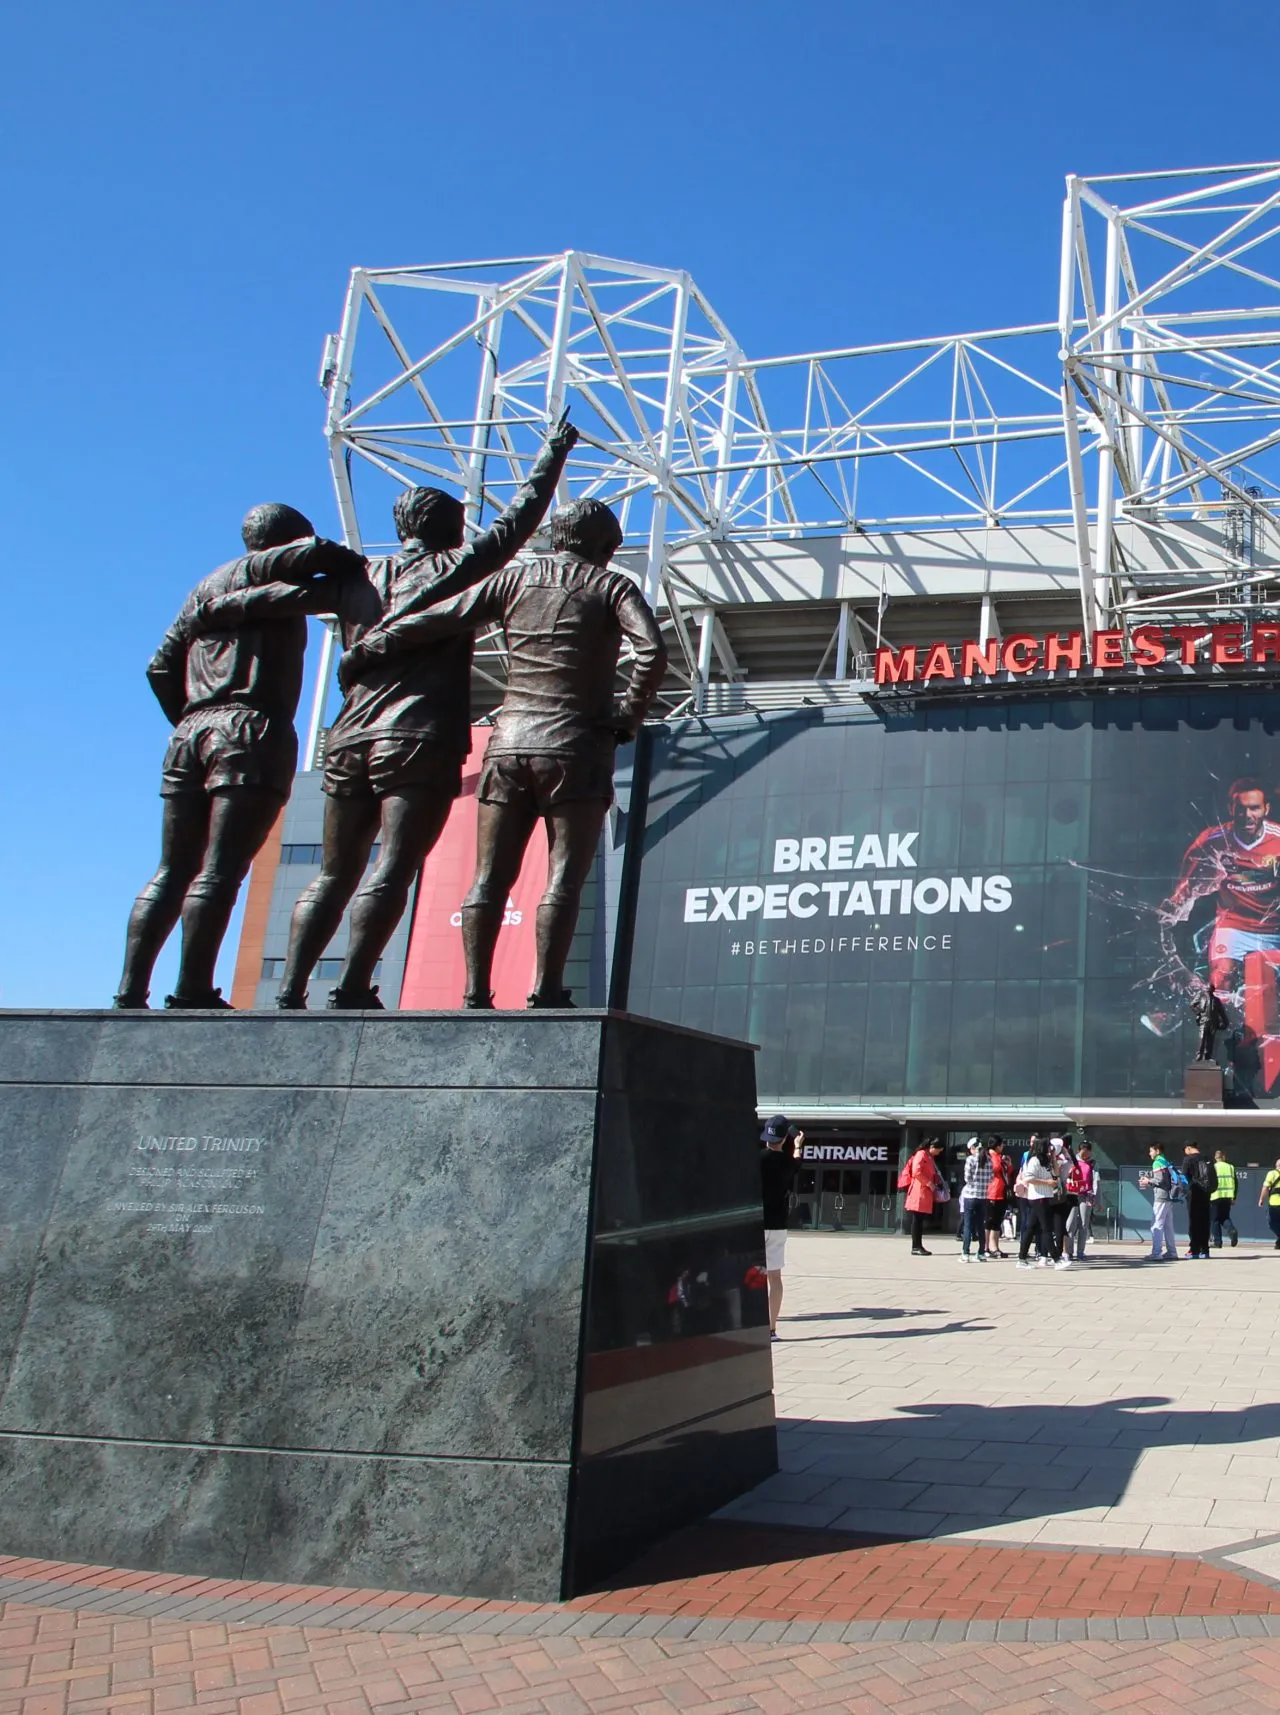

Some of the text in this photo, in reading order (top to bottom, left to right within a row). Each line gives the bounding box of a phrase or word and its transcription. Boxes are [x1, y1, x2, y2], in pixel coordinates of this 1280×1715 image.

[773, 832, 920, 873] BREAK
[1226, 882, 1272, 892] CHEVROLET
[684, 875, 1013, 923] EXPECTATIONS
[449, 910, 523, 927] aas
[731, 935, 952, 956] #BETHEDIFFERENCE
[138, 1135, 265, 1152] UNITED TRINITY
[803, 1145, 888, 1161] ENTRANCE
[211, 1204, 264, 1215] FERGUSON
